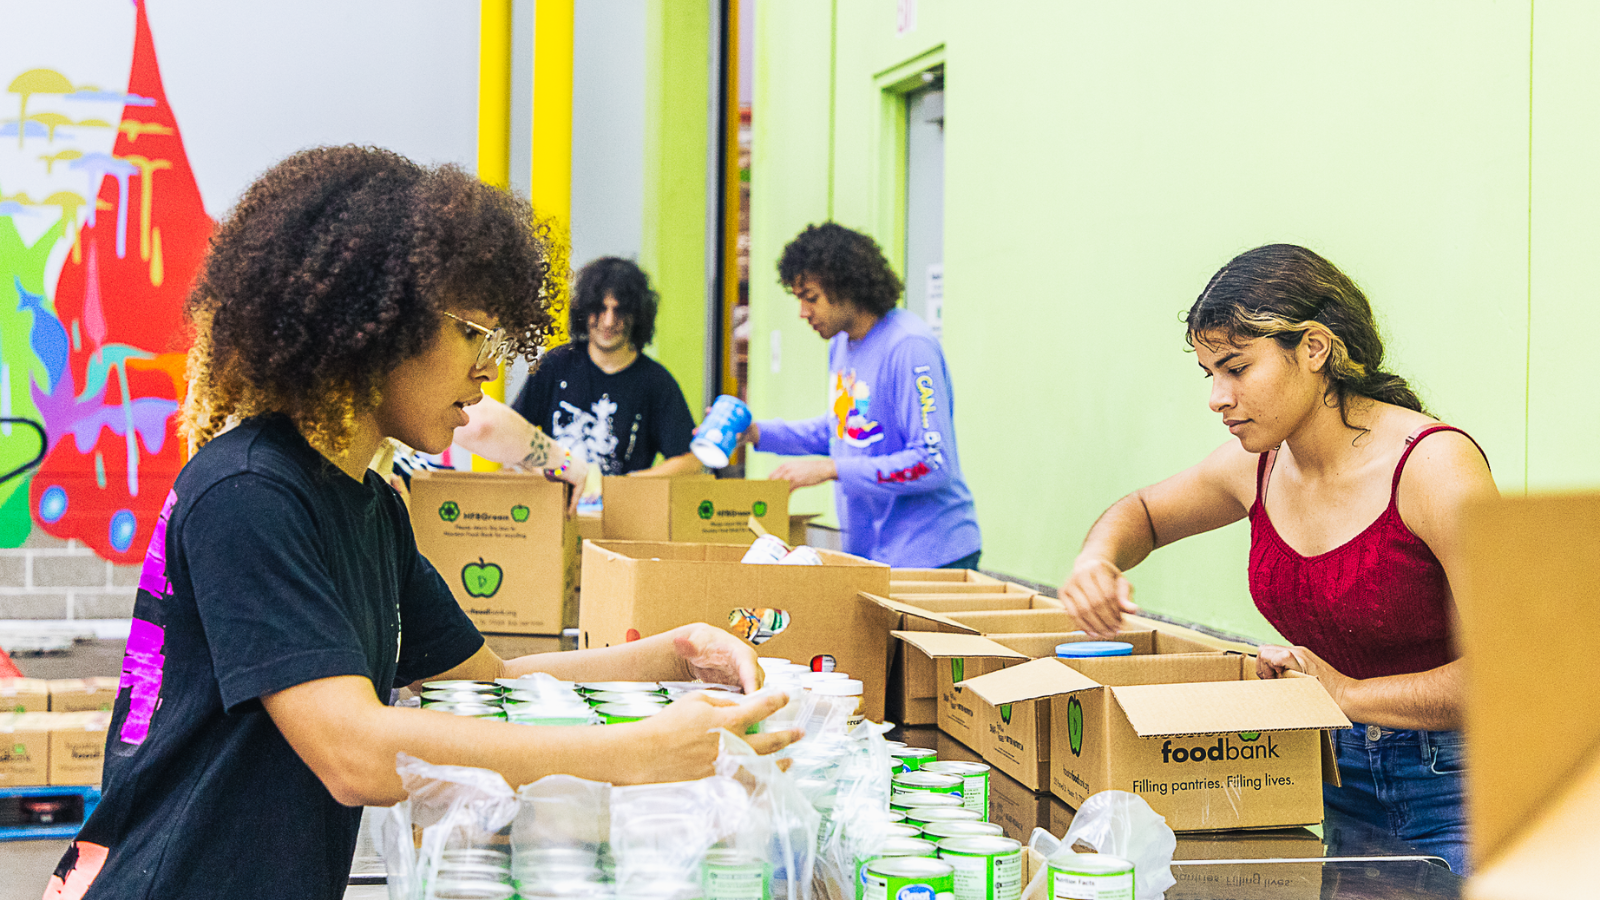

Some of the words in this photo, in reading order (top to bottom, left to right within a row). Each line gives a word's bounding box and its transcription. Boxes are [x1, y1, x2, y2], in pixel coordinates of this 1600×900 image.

[1161, 735, 1280, 763] foodbank
[1133, 779, 1168, 795] Filling
[1171, 778, 1223, 795] pantries.
[1227, 774, 1262, 790] Filling
[1265, 773, 1294, 787] lives.
